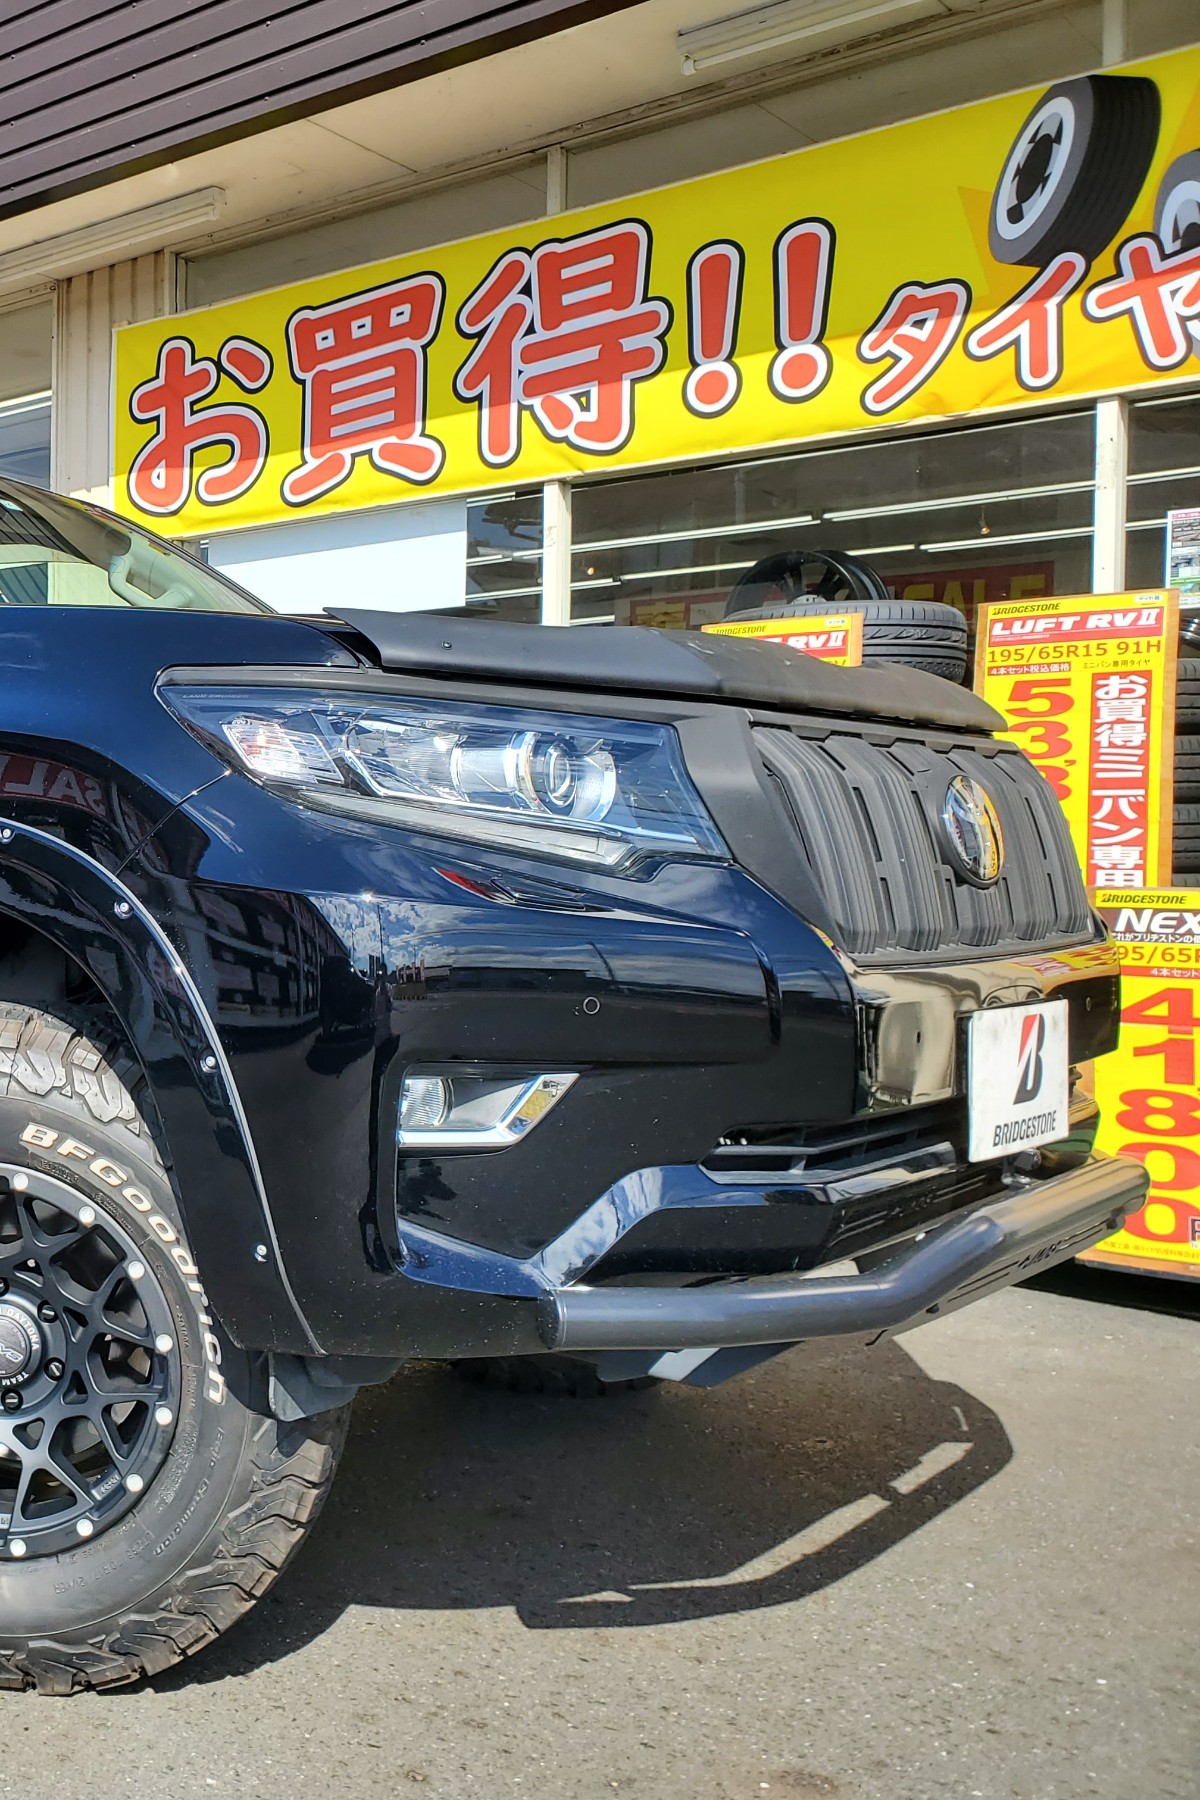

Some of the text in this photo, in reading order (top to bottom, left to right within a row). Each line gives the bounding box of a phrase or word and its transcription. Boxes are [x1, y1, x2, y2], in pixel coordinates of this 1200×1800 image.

[992, 602, 1061, 615] BRIDGESTONE
[991, 616, 1081, 637] LUFT
[988, 639, 1161, 663] 195/65R15 91H
[1083, 659, 1151, 670] ミニバン専用タイヤ
[1090, 674, 1149, 887] お買得ミニバン専用
[1101, 894, 1187, 904] BRIDGESTONE
[1117, 945, 1200, 964] 95/65
[993, 1110, 1057, 1147] BRIDGESTONE
[6, 1308, 40, 1351] DAYTONA
[2, 1371, 30, 1386] TEAM
